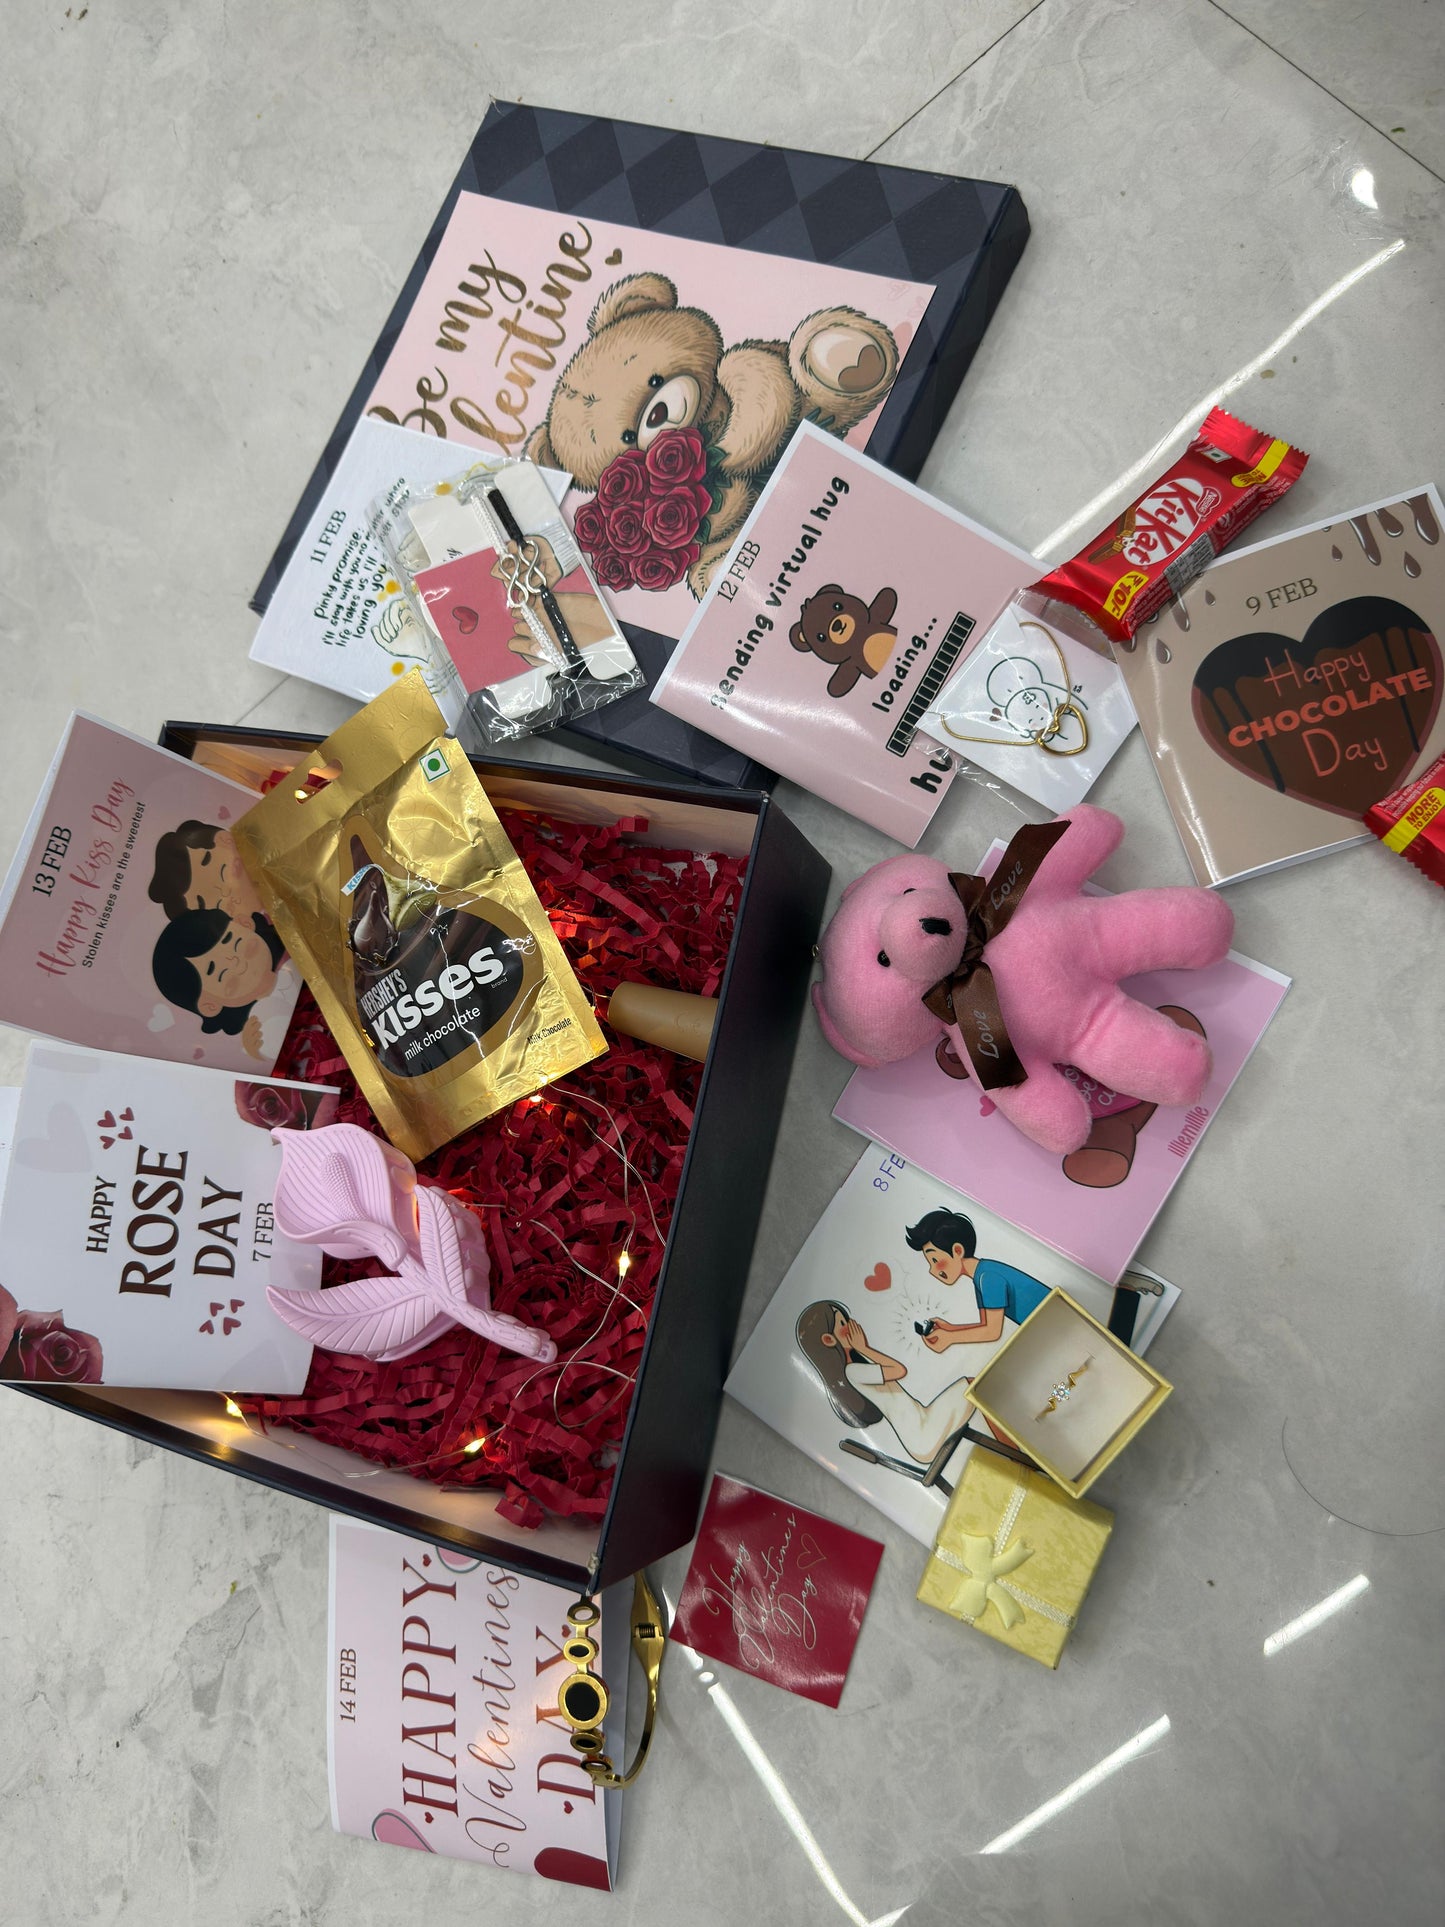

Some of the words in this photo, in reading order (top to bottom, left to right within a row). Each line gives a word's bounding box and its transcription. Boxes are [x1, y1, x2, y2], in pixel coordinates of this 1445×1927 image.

[435, 249, 527, 352] my
[450, 221, 592, 458] lentine
[310, 549, 326, 565] 11
[319, 510, 347, 548] FEB
[765, 524, 823, 609] virtual
[810, 476, 850, 522] hug
[331, 604, 345, 627] stay
[340, 578, 355, 601] with
[350, 557, 362, 576] you
[360, 543, 368, 555] no
[716, 580, 739, 604] 12
[728, 540, 762, 583] FEB
[343, 594, 361, 625] takes
[353, 599, 378, 639] loving
[1245, 595, 1262, 617] 9
[1265, 577, 1318, 609] FEB
[335, 626, 352, 648] life
[1264, 648, 1371, 697] Happy
[1228, 667, 1433, 748] CHOCOLATE
[909, 754, 954, 794] hu
[1301, 727, 1389, 777] Day
[91, 776, 136, 833] Day
[125, 801, 147, 850] sweetest
[1413, 820, 1423, 831] TO
[1422, 799, 1443, 824] ENJOY
[40, 825, 72, 872] FEB
[68, 838, 115, 889] Kiss
[117, 851, 131, 871] the
[31, 872, 56, 898] 13
[112, 872, 125, 891] are
[990, 860, 1023, 911] Love
[95, 893, 118, 932] kisses
[36, 896, 97, 979] Happy
[82, 931, 104, 969] Stolen
[359, 967, 408, 1020] HERSHEY'S
[404, 1038, 424, 1062] milk
[422, 1006, 481, 1048] chocolate
[541, 1015, 573, 1040] Chocolate
[973, 1009, 1000, 1059] Love
[872, 1177, 889, 1192] 8
[879, 1153, 906, 1180] FE
[85, 1175, 117, 1254] HAPPY
[118, 1144, 189, 1298] ROSE
[192, 1175, 243, 1279] DAY
[254, 1201, 275, 1246] FEB
[252, 1250, 272, 1262] 7
[702, 1540, 751, 1634] Happy
[770, 1573, 818, 1650] Day
[339, 1648, 357, 1696] FEB
[401, 1557, 459, 1818] HAPPY
[339, 1699, 356, 1724] 14
